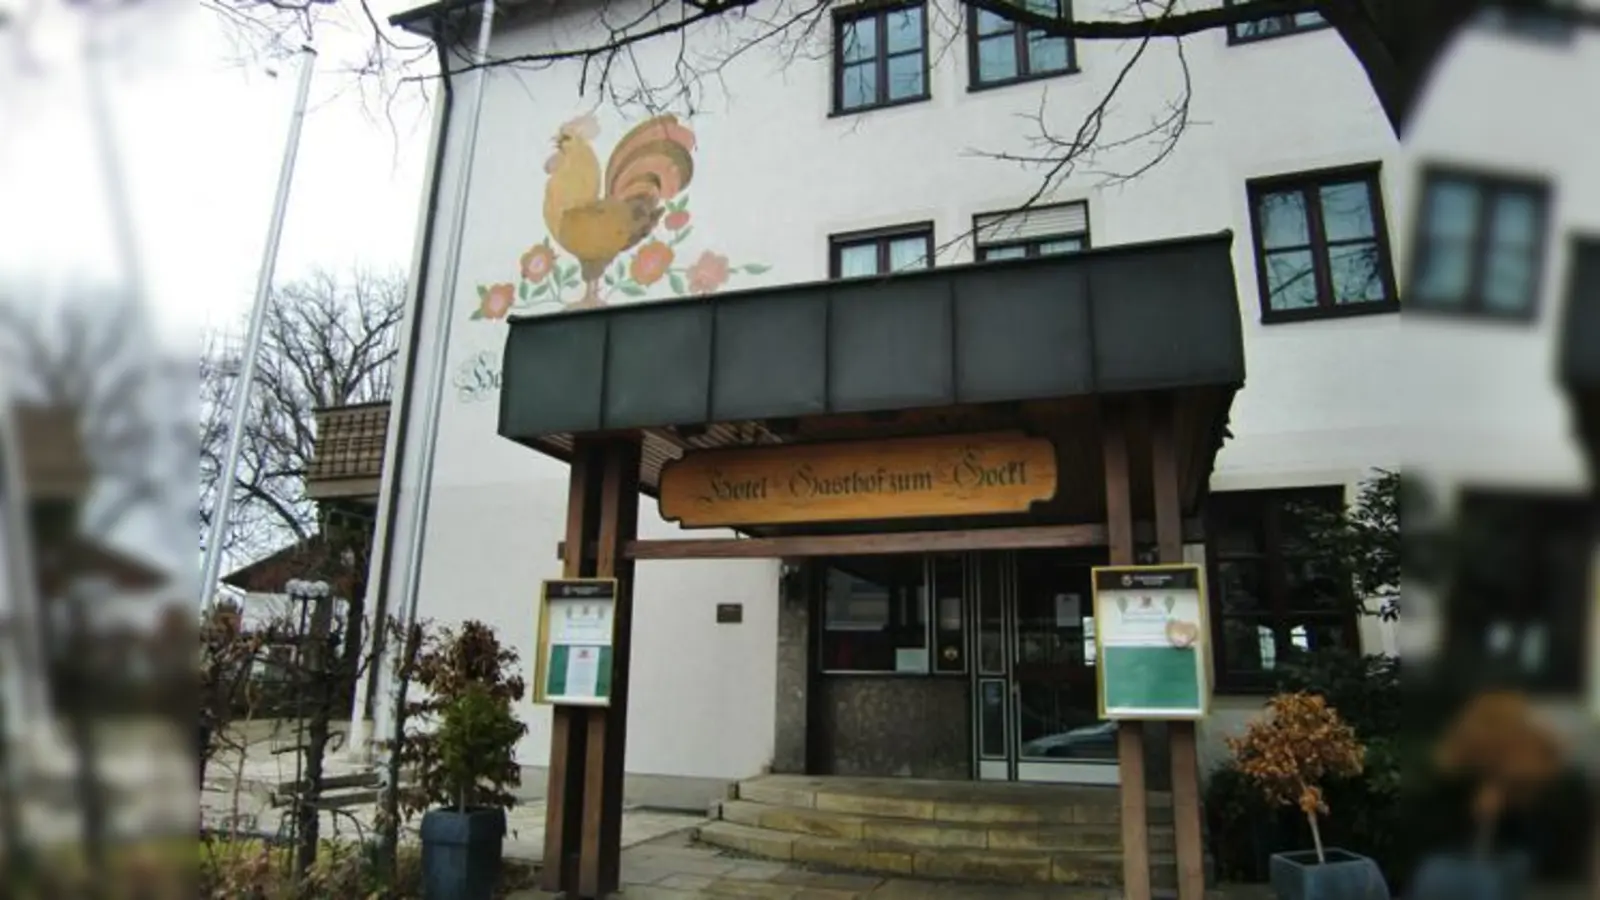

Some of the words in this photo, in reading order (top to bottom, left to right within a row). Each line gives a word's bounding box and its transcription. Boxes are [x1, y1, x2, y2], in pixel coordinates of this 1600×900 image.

[697, 467, 767, 505] Hotel
[788, 461, 886, 498] Gasthof
[889, 469, 932, 495] zum
[953, 446, 1027, 491] Gockl
